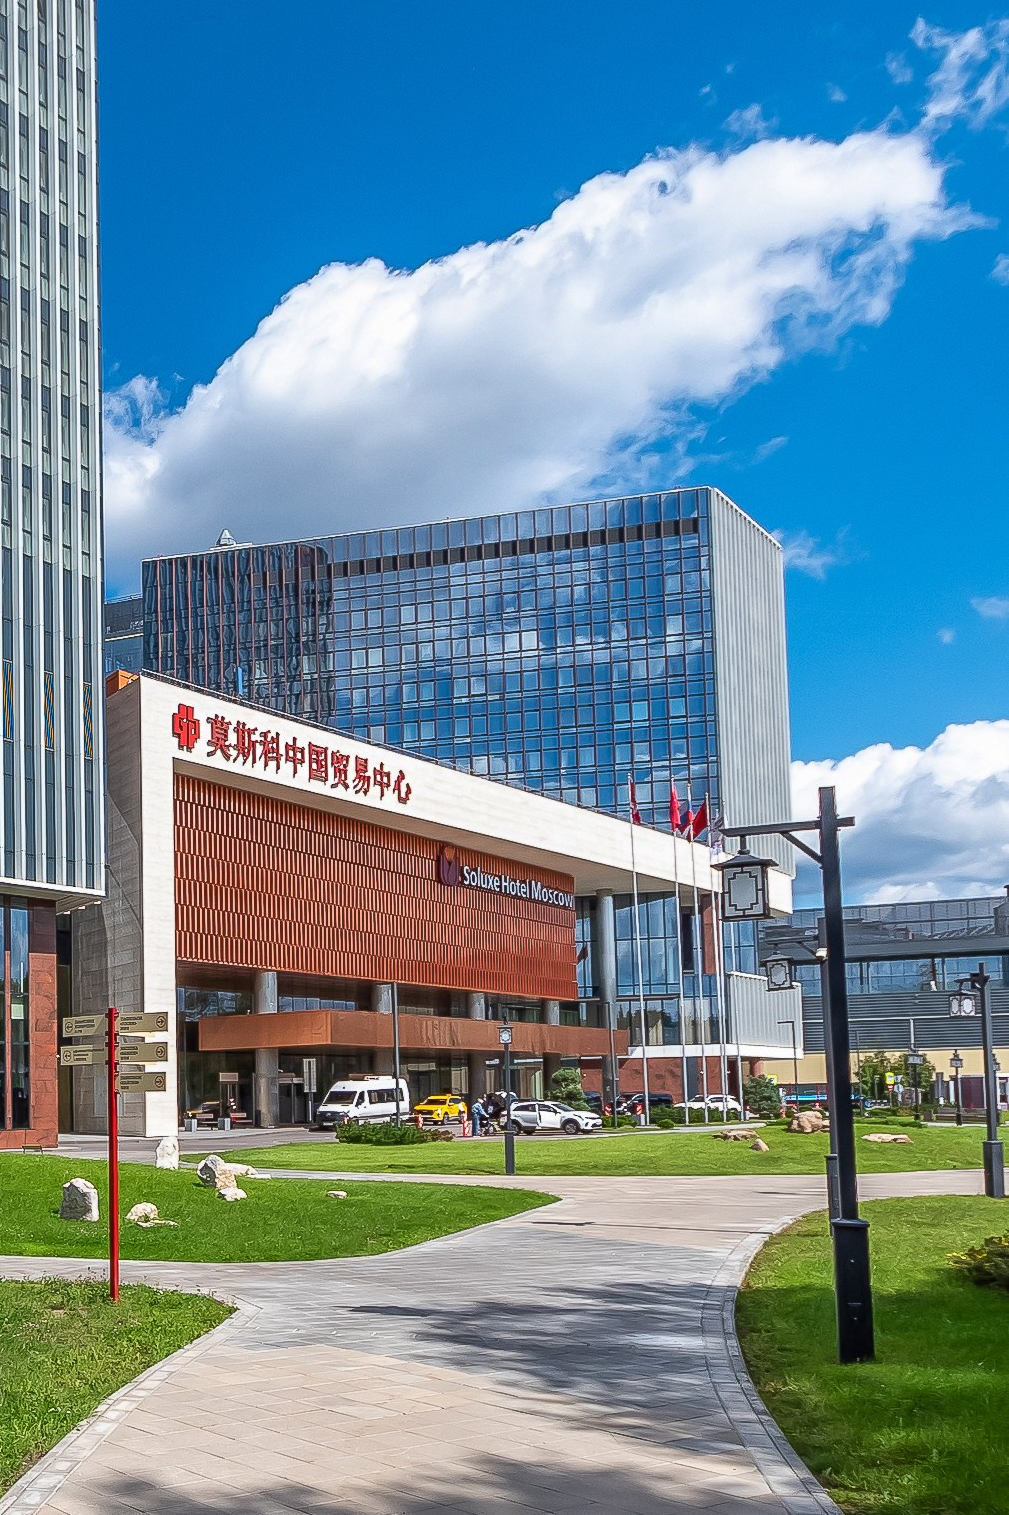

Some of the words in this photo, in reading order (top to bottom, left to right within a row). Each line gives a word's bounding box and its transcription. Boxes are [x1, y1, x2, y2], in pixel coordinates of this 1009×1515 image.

[206, 714, 412, 805] 莫斯科中国贸易中心
[463, 866, 500, 891] Soluxe
[501, 875, 530, 898] Hotel
[531, 880, 574, 907] Moscow
